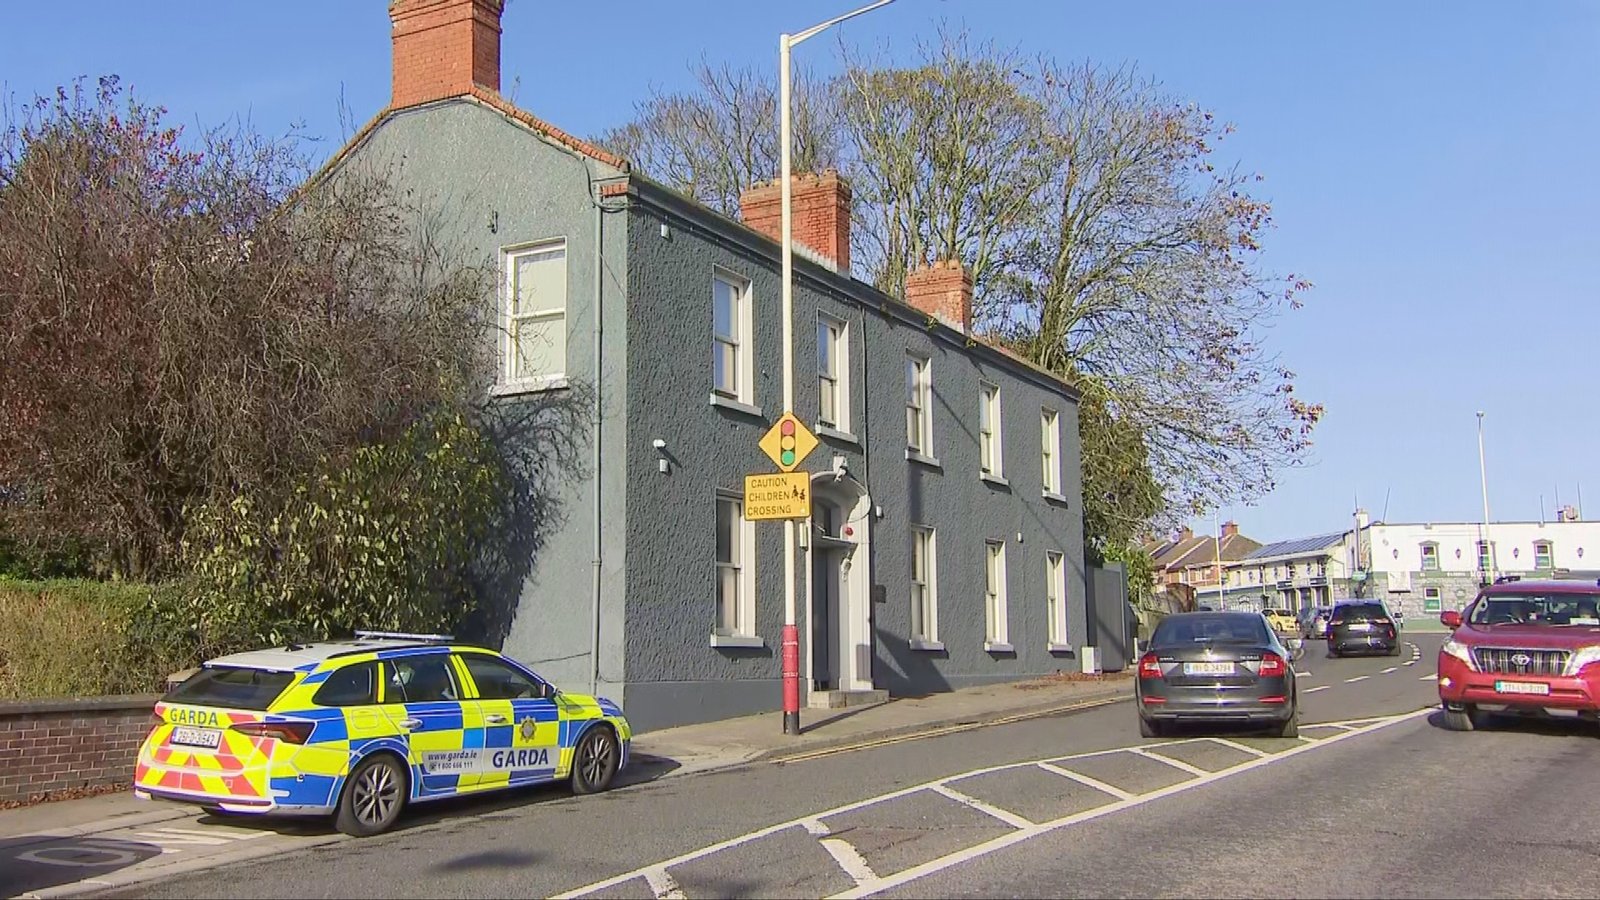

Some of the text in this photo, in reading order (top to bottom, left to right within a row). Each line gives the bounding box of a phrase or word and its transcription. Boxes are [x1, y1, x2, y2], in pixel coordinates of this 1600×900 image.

[751, 478, 787, 488] CAUTION
[749, 491, 790, 502] CHILDREN
[747, 505, 791, 516] CROSSING
[170, 707, 218, 726] GARDA
[428, 750, 477, 761] www.garda.ie
[492, 748, 549, 768] GARDA
